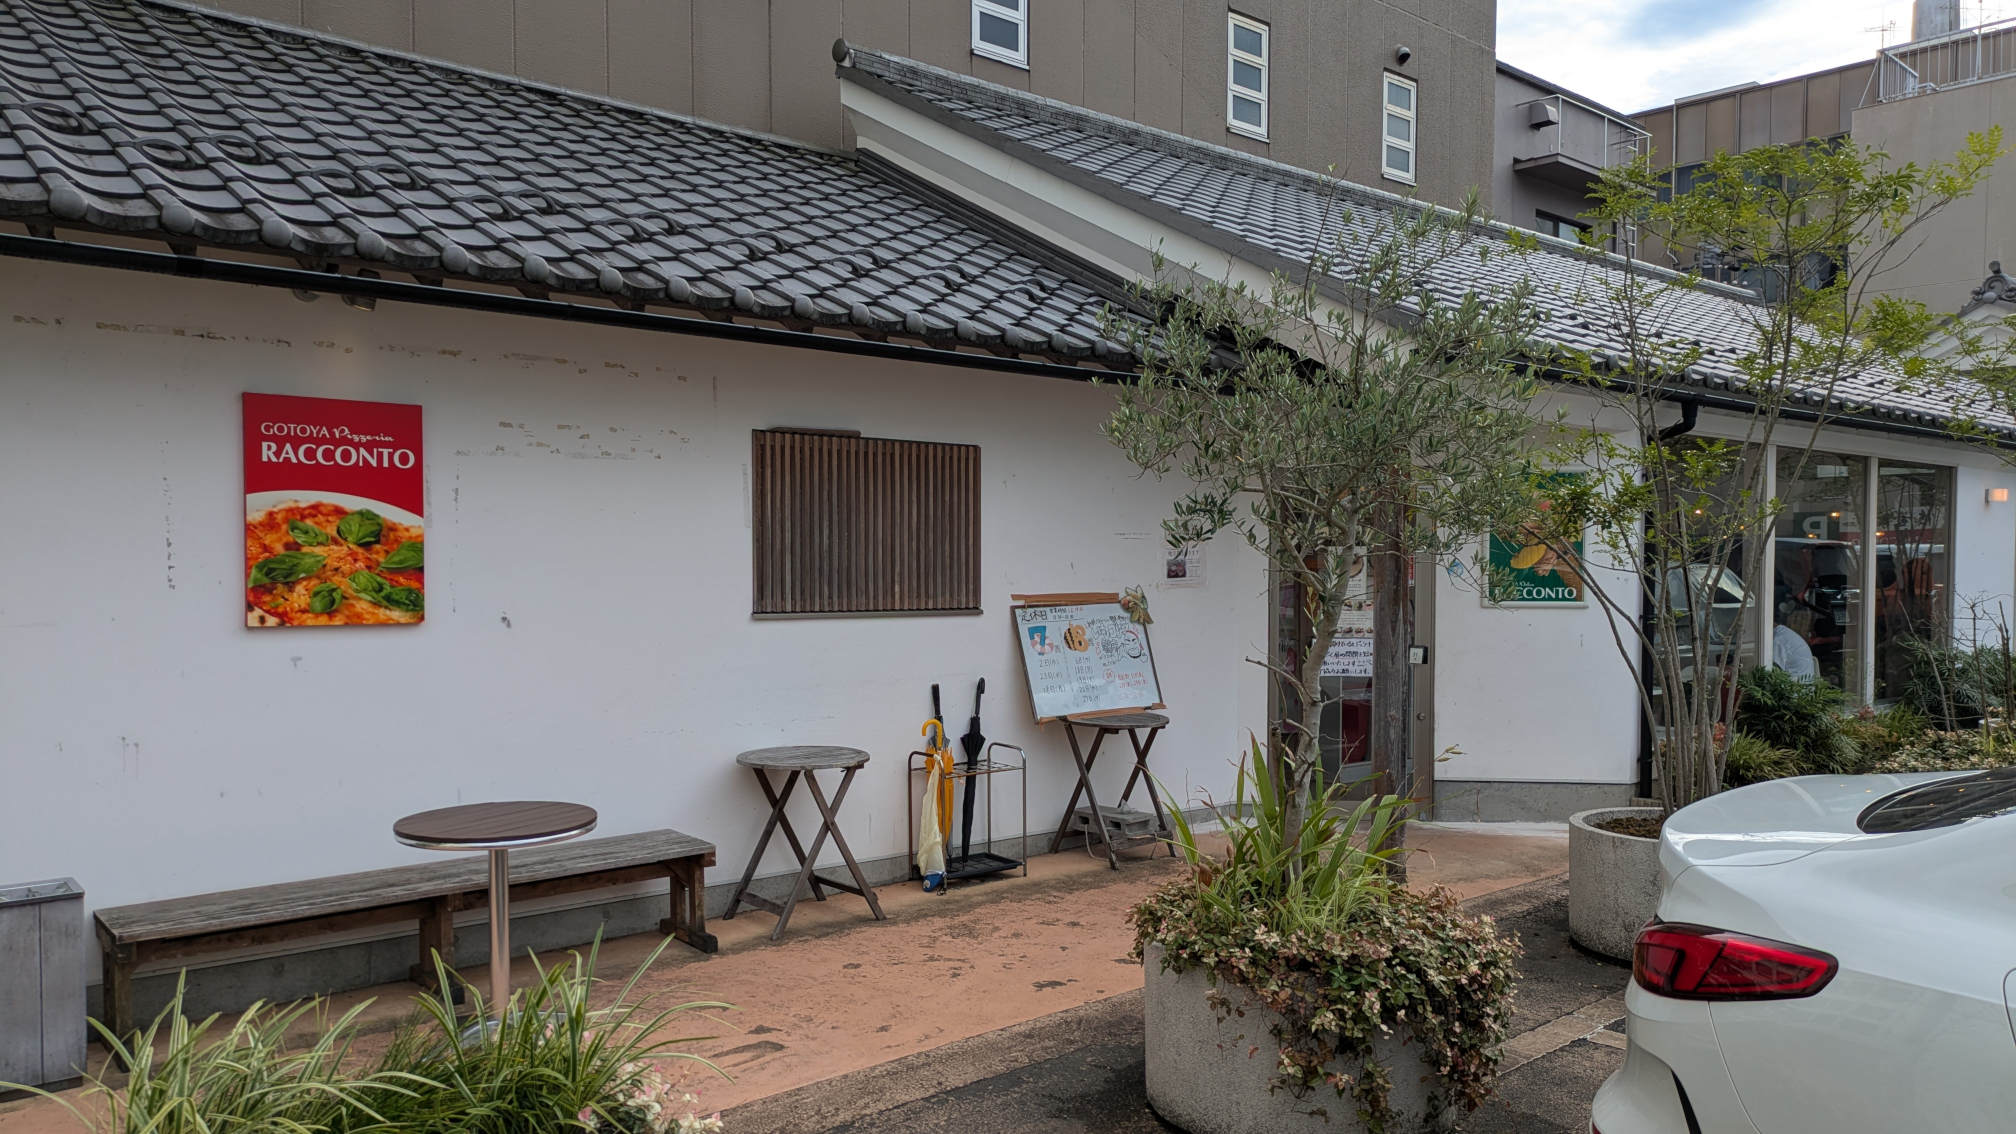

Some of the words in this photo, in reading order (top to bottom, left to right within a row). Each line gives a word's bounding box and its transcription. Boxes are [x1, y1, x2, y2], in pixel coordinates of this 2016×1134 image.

[261, 422, 330, 438] GOTOYA
[333, 426, 395, 443] Pizzeria
[261, 441, 415, 468] RACCONTO
